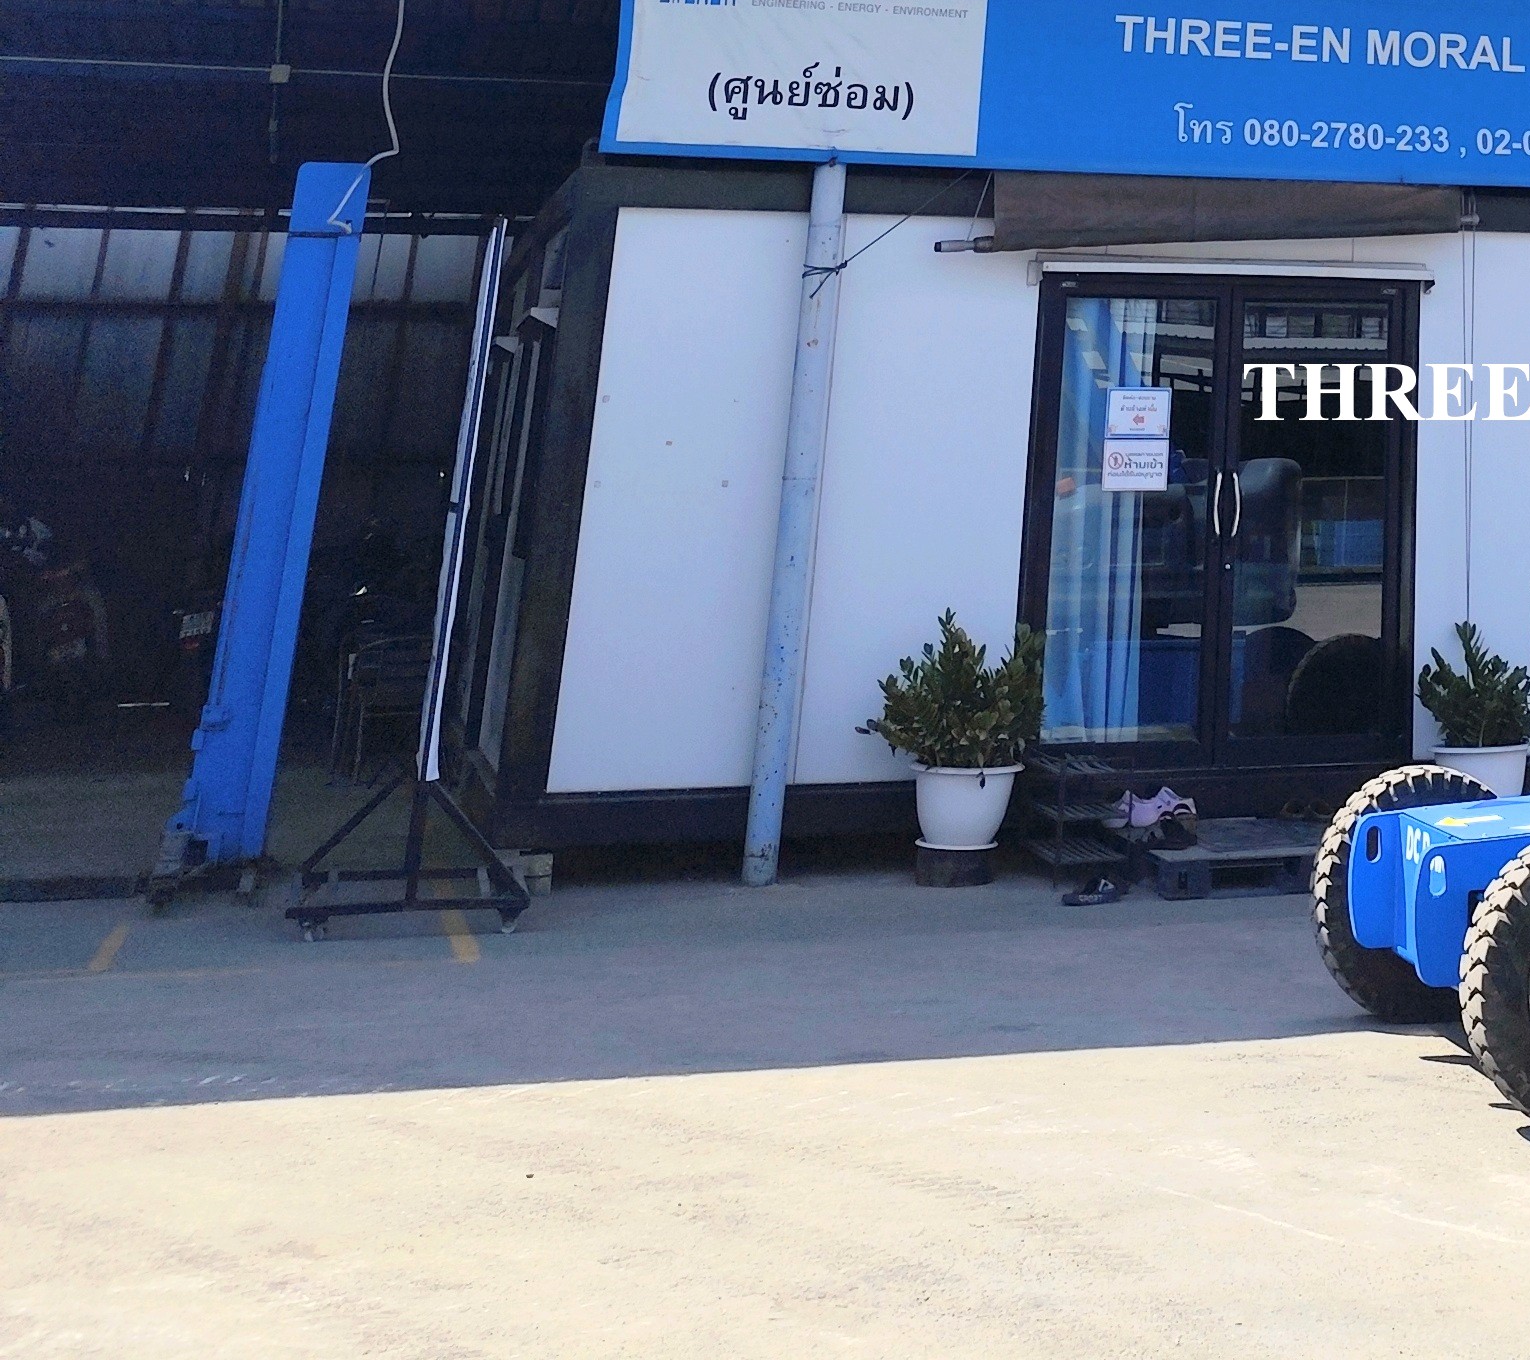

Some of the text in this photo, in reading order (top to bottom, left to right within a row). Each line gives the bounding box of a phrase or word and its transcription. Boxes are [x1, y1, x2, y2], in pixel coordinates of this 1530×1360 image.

[837, 1, 882, 15] ENERGY
[892, 5, 969, 20] ENVIRONMENT
[1114, 13, 1351, 65] THREE-EN
[1365, 28, 1526, 74] MORAL
[707, 61, 914, 121] (ศูนย์ซ่อม)
[1173, 102, 1234, 146] โทร
[1243, 117, 1450, 154] 080-2780-233
[1123, 457, 1164, 470] ห้ามเข้า
